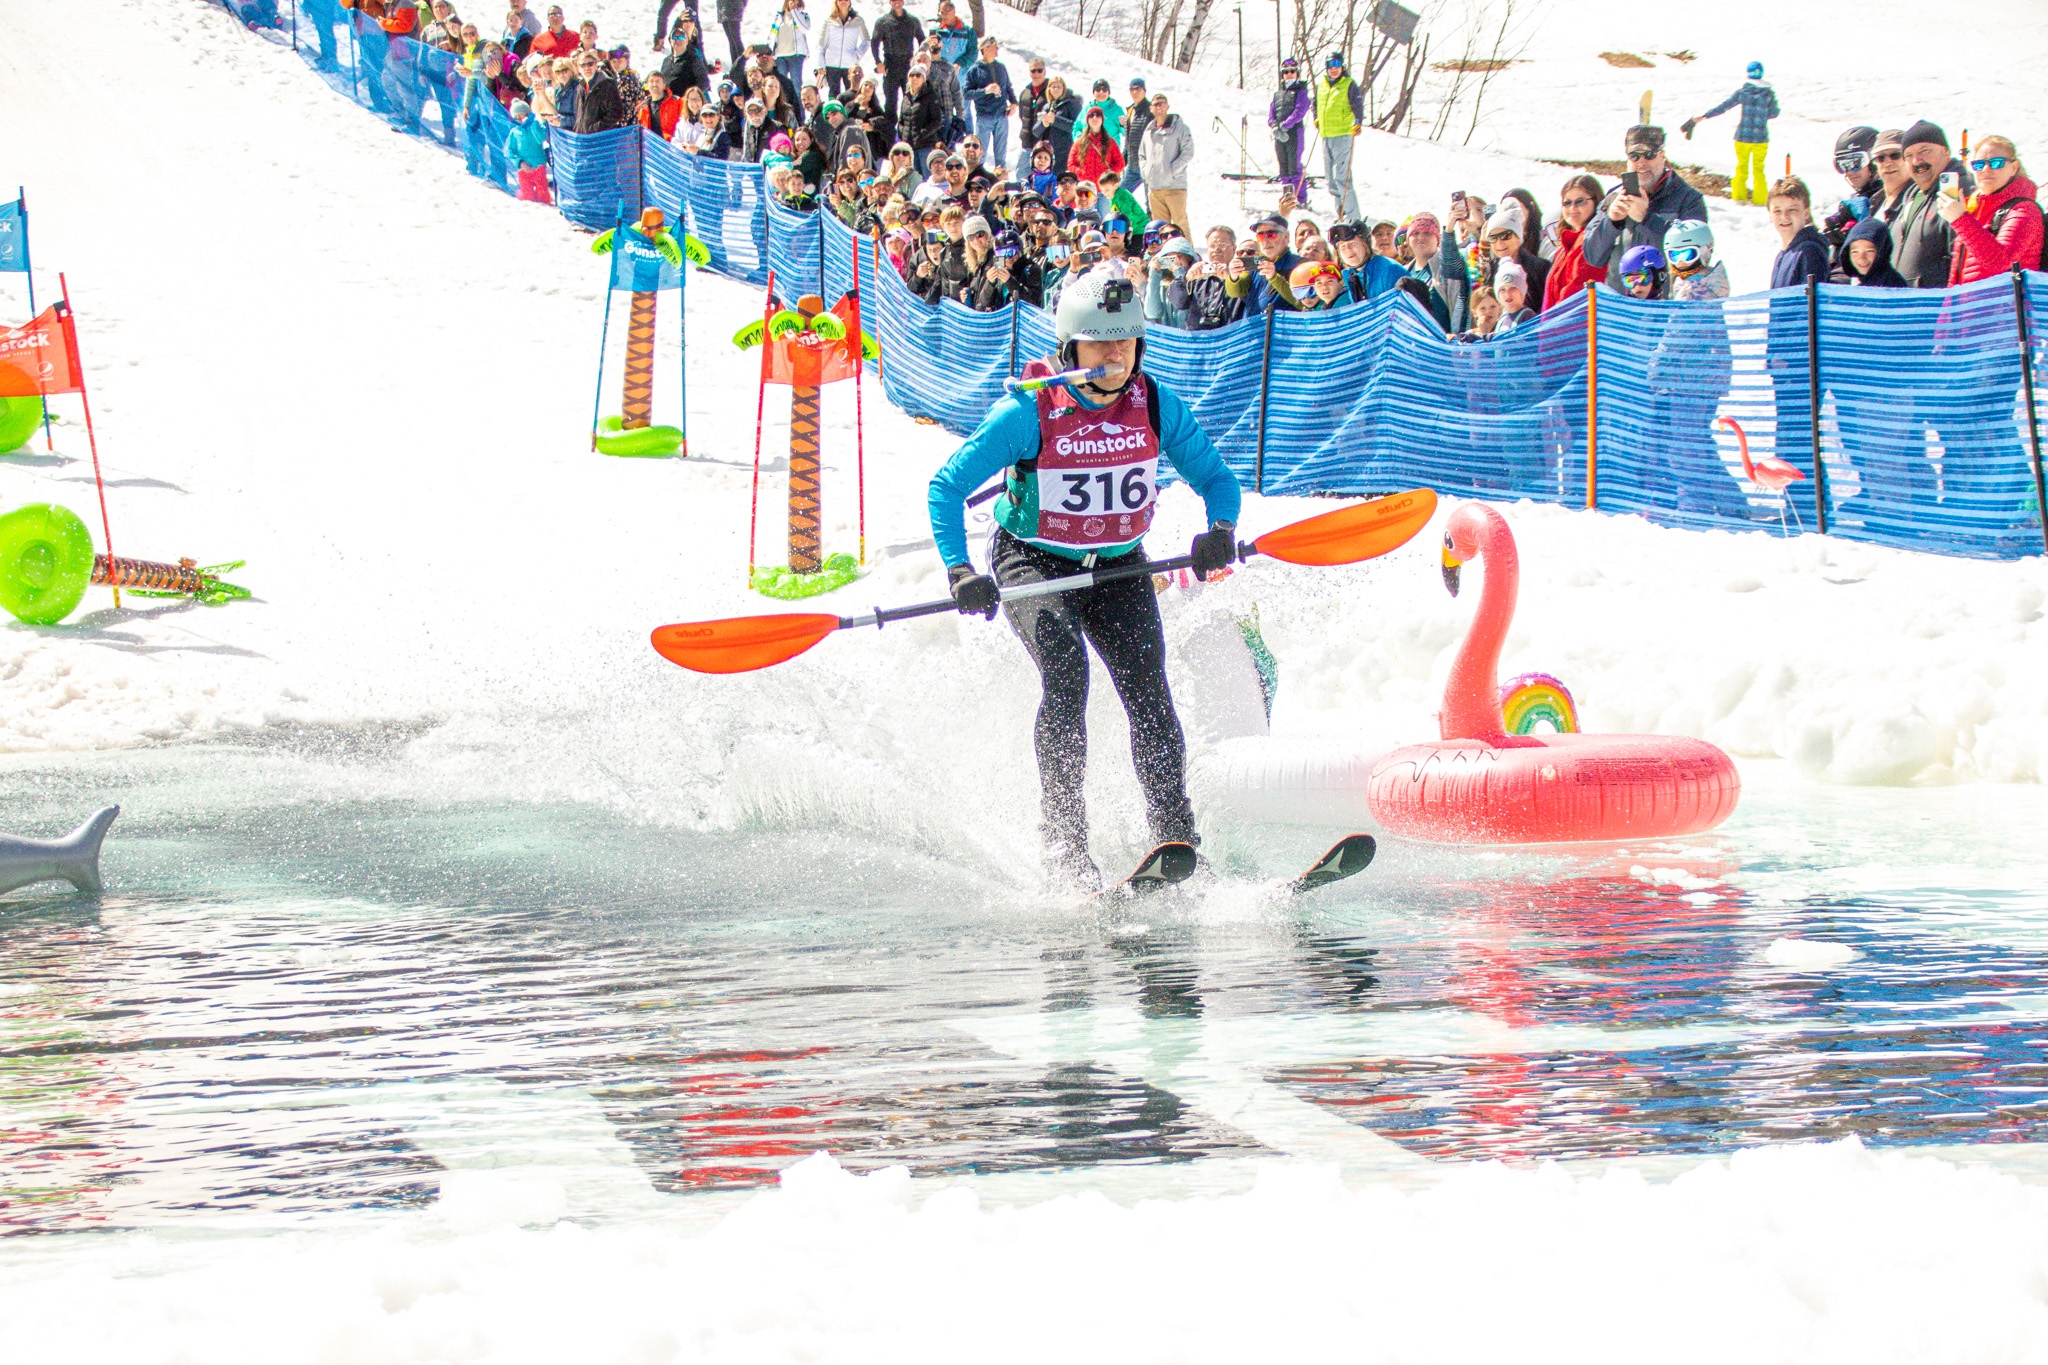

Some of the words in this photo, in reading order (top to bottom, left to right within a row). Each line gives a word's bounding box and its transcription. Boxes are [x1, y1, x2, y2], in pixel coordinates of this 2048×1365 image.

[624, 241, 665, 258] Gunst
[0, 333, 51, 352] stock
[1056, 432, 1147, 456] Gunstock
[1112, 454, 1133, 462] RESORT
[1061, 467, 1148, 512] 316
